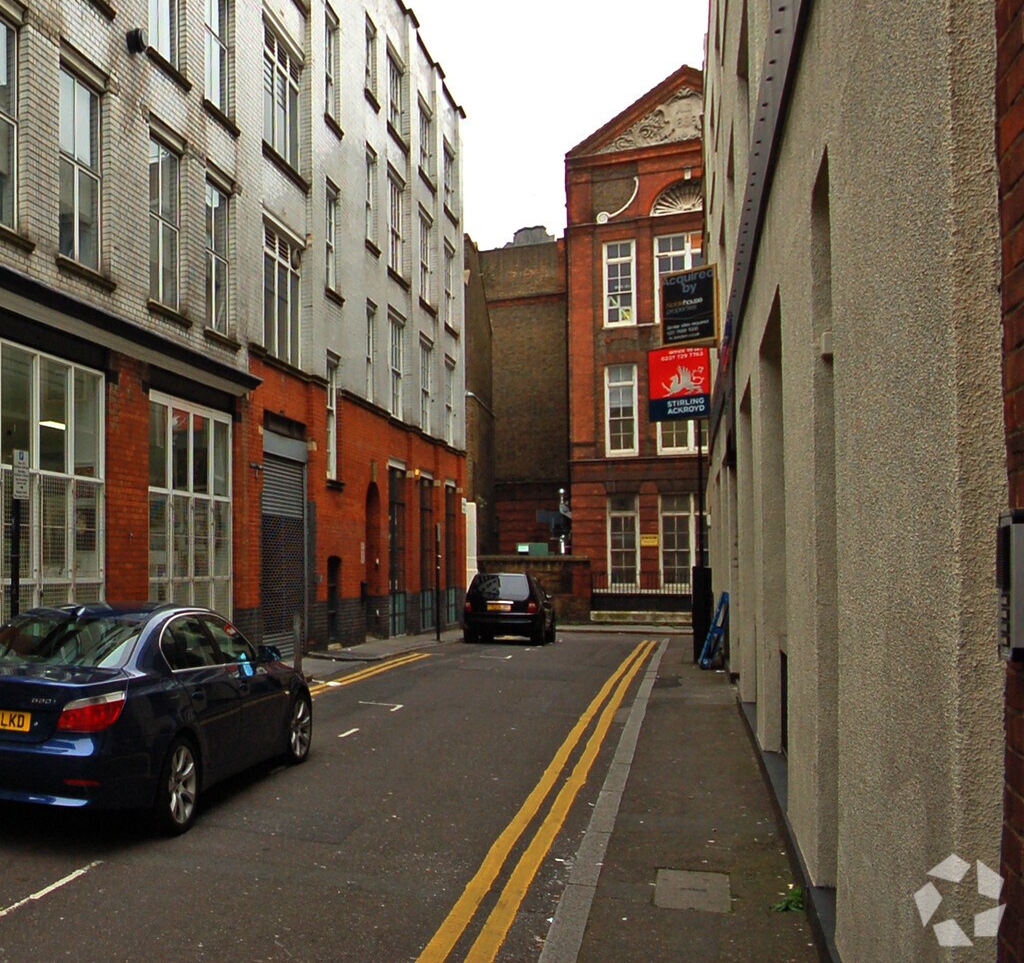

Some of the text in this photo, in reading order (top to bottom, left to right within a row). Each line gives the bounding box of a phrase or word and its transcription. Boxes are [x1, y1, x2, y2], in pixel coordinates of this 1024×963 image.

[682, 282, 697, 293] by
[667, 397, 705, 408] STIRLING
[667, 404, 706, 415] ACKROYD
[0, 712, 25, 728] LKD
